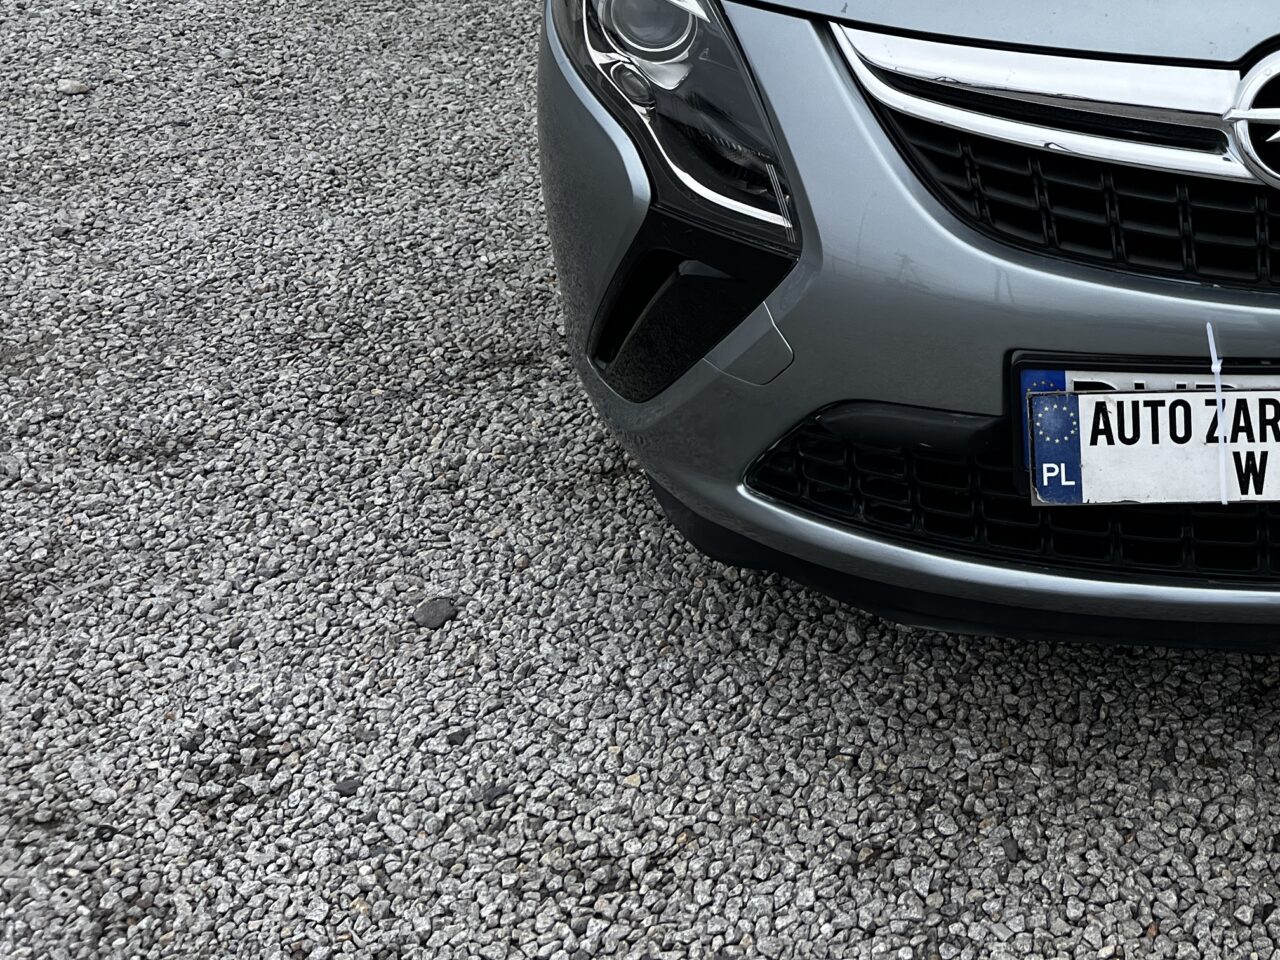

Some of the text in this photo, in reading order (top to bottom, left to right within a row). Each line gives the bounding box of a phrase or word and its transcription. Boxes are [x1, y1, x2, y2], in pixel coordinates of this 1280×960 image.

[1090, 399, 1193, 446] AUTO
[1042, 463, 1076, 486] PL
[1232, 450, 1269, 495] W
